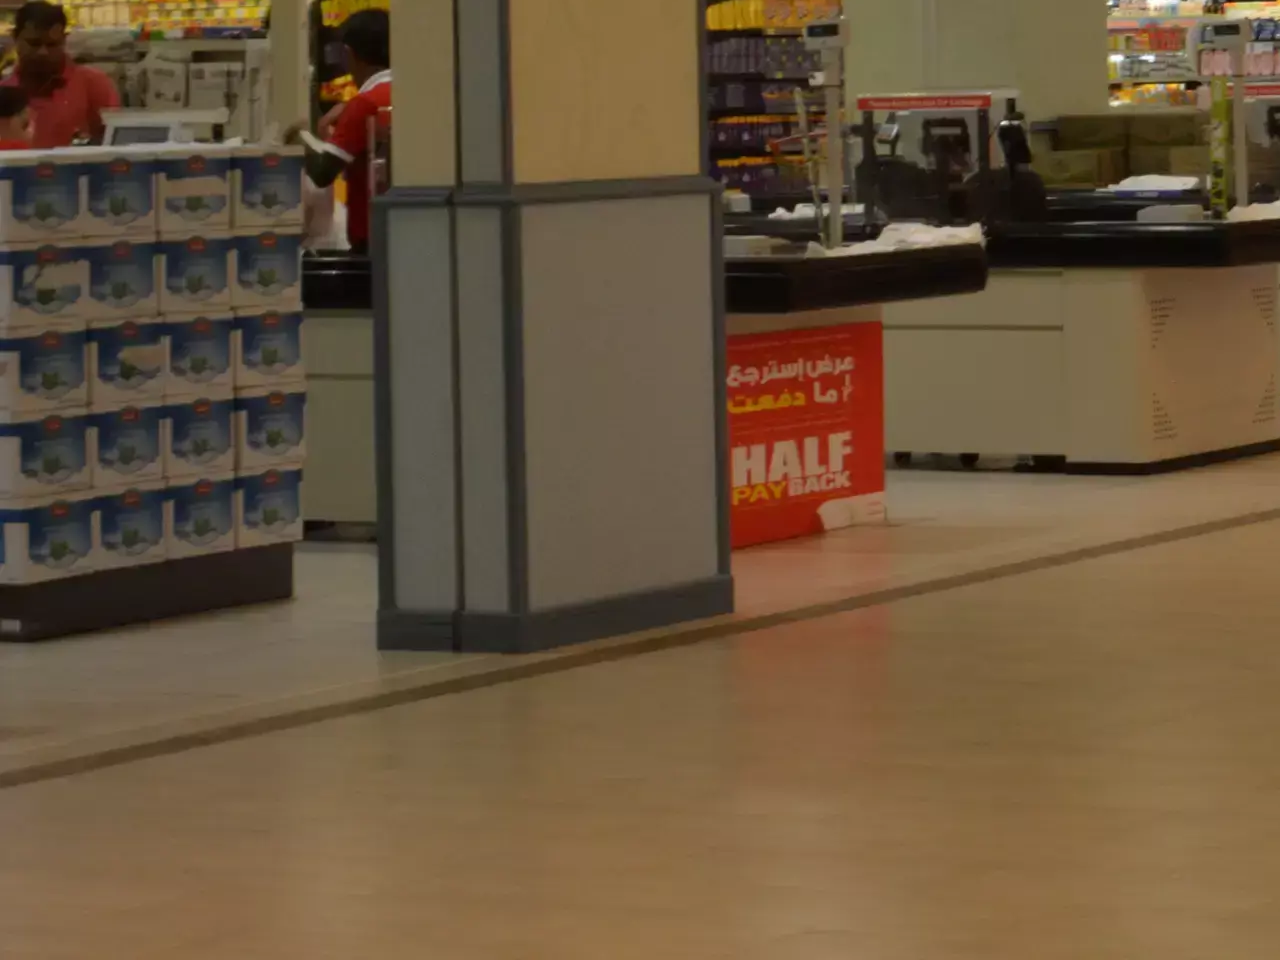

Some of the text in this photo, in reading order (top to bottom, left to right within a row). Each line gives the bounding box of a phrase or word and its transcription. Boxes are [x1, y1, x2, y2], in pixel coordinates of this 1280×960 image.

[806, 353, 855, 378] عرض
[727, 387, 807, 414] دفعت
[731, 430, 854, 487] HALF
